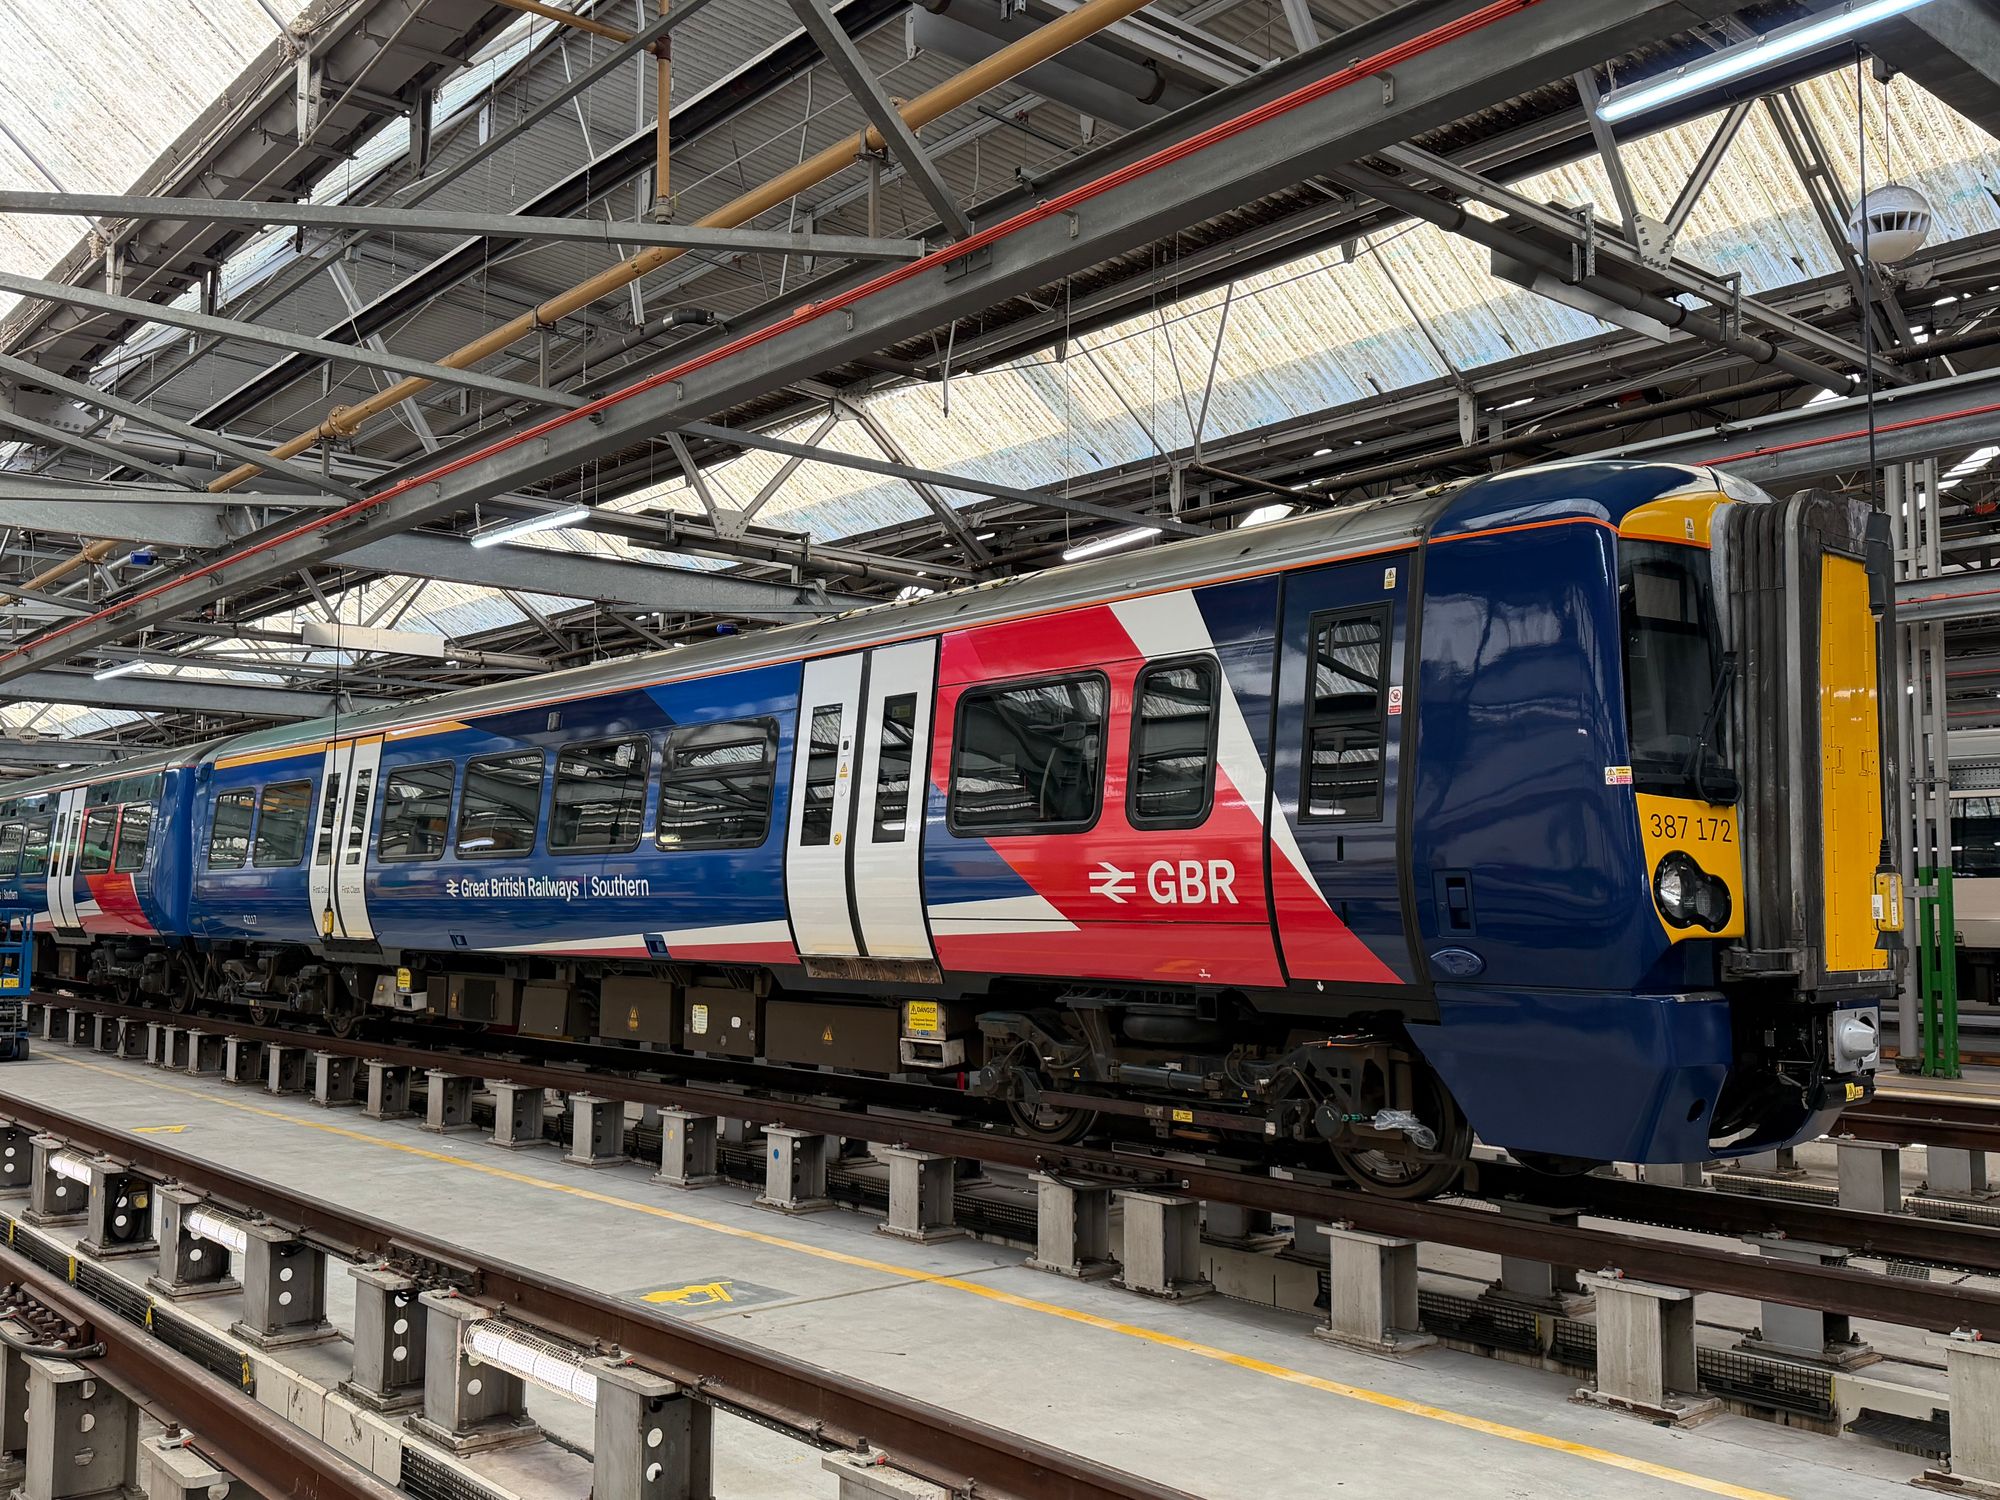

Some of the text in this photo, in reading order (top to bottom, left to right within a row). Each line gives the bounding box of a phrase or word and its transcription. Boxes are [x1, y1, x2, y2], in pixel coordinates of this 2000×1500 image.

[1650, 813, 1732, 843] 387 172
[461, 874, 650, 902] Great British Railways Southern
[1147, 859, 1239, 904] GBR
[916, 1006, 936, 1014] DANGER
